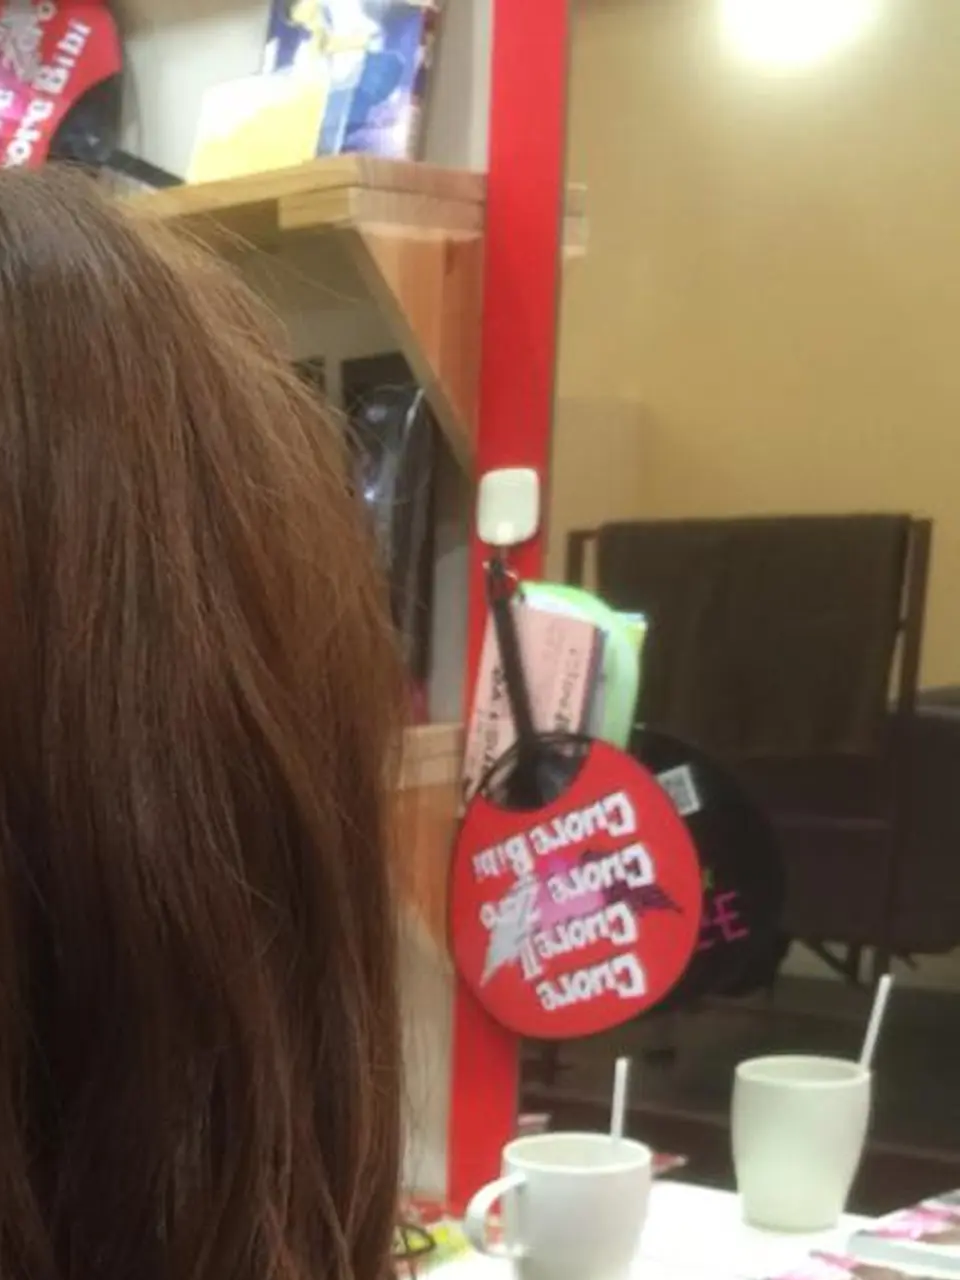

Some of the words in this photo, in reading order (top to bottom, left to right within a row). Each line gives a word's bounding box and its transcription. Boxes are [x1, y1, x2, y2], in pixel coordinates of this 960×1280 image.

[31, 18, 92, 94] Bibi
[529, 791, 637, 855] Cuore
[472, 833, 534, 884] Bibi
[547, 842, 655, 904] Cuore
[537, 901, 638, 957] Cuore
[535, 952, 647, 1010] Cuore
